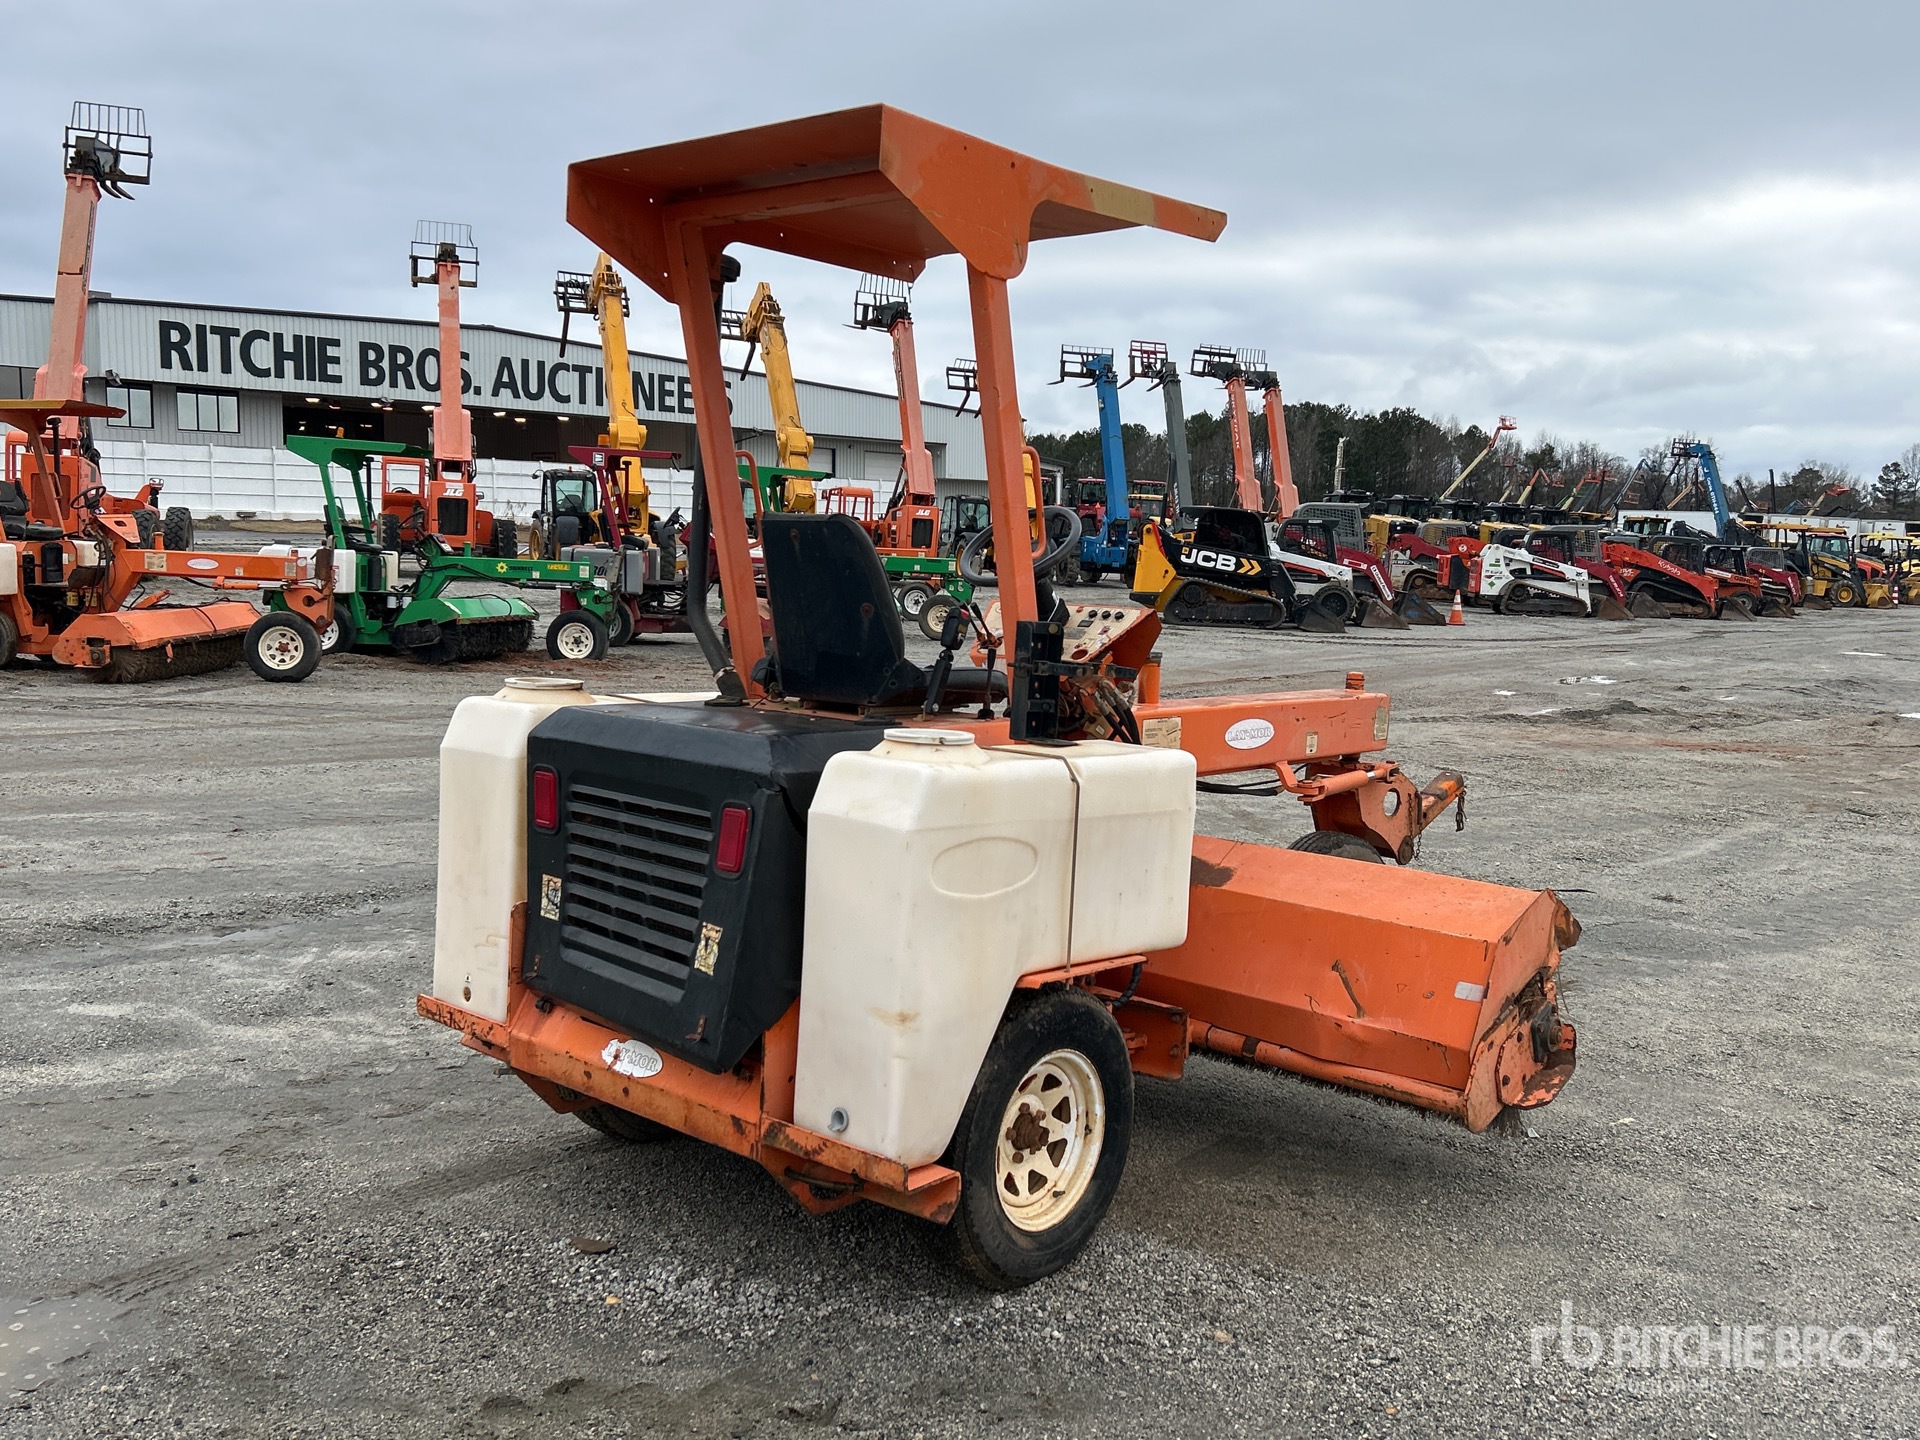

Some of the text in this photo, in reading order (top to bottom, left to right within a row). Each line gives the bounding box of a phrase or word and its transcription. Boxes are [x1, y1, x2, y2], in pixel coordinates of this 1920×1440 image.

[159, 320, 343, 384] RITCHIE
[491, 356, 733, 416] AUCTINEE
[443, 488, 464, 497] JLG
[915, 509, 931, 517] JLG
[1180, 548, 1237, 572] JCB
